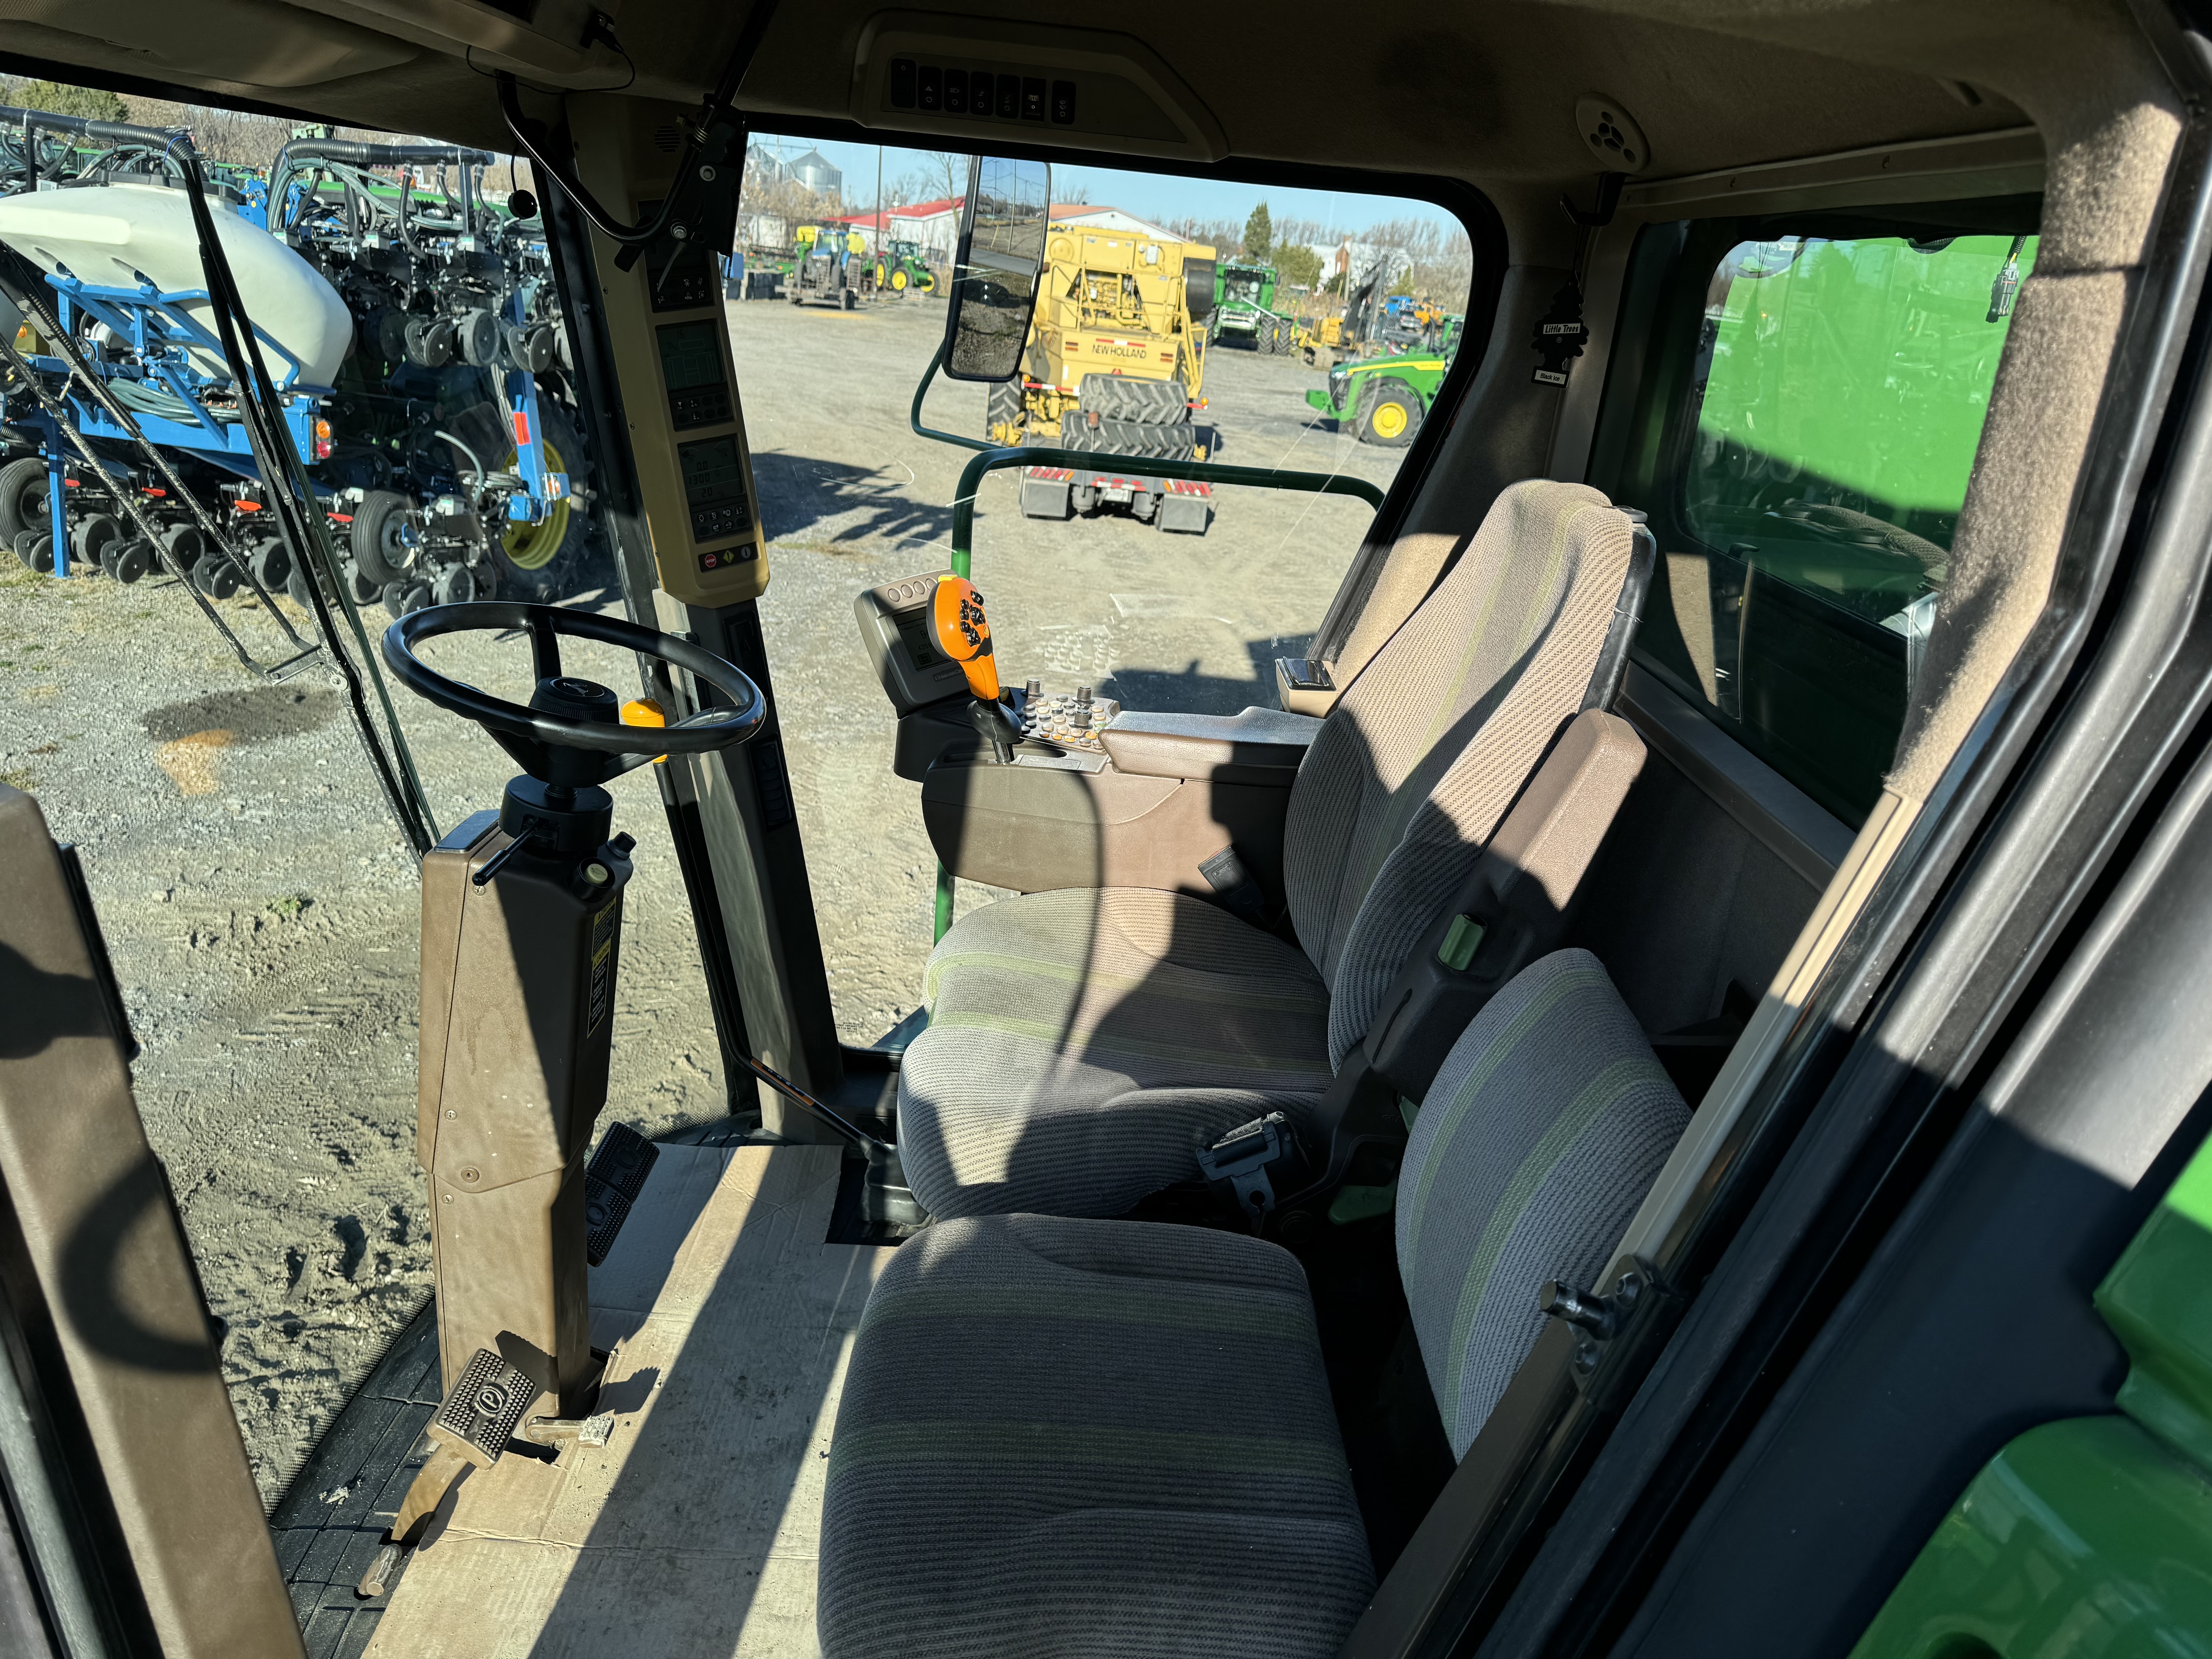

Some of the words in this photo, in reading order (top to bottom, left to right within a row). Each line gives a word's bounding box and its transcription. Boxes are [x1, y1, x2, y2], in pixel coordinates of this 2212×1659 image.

[1545, 325, 1561, 333] Little
[1563, 324, 1579, 333] Trees
[1092, 344, 1109, 354] NEW
[1110, 347, 1147, 359] HOLLAND
[689, 473, 710, 485] 1300
[701, 487, 713, 498] 20
[597, 943, 610, 962] CAUTION
